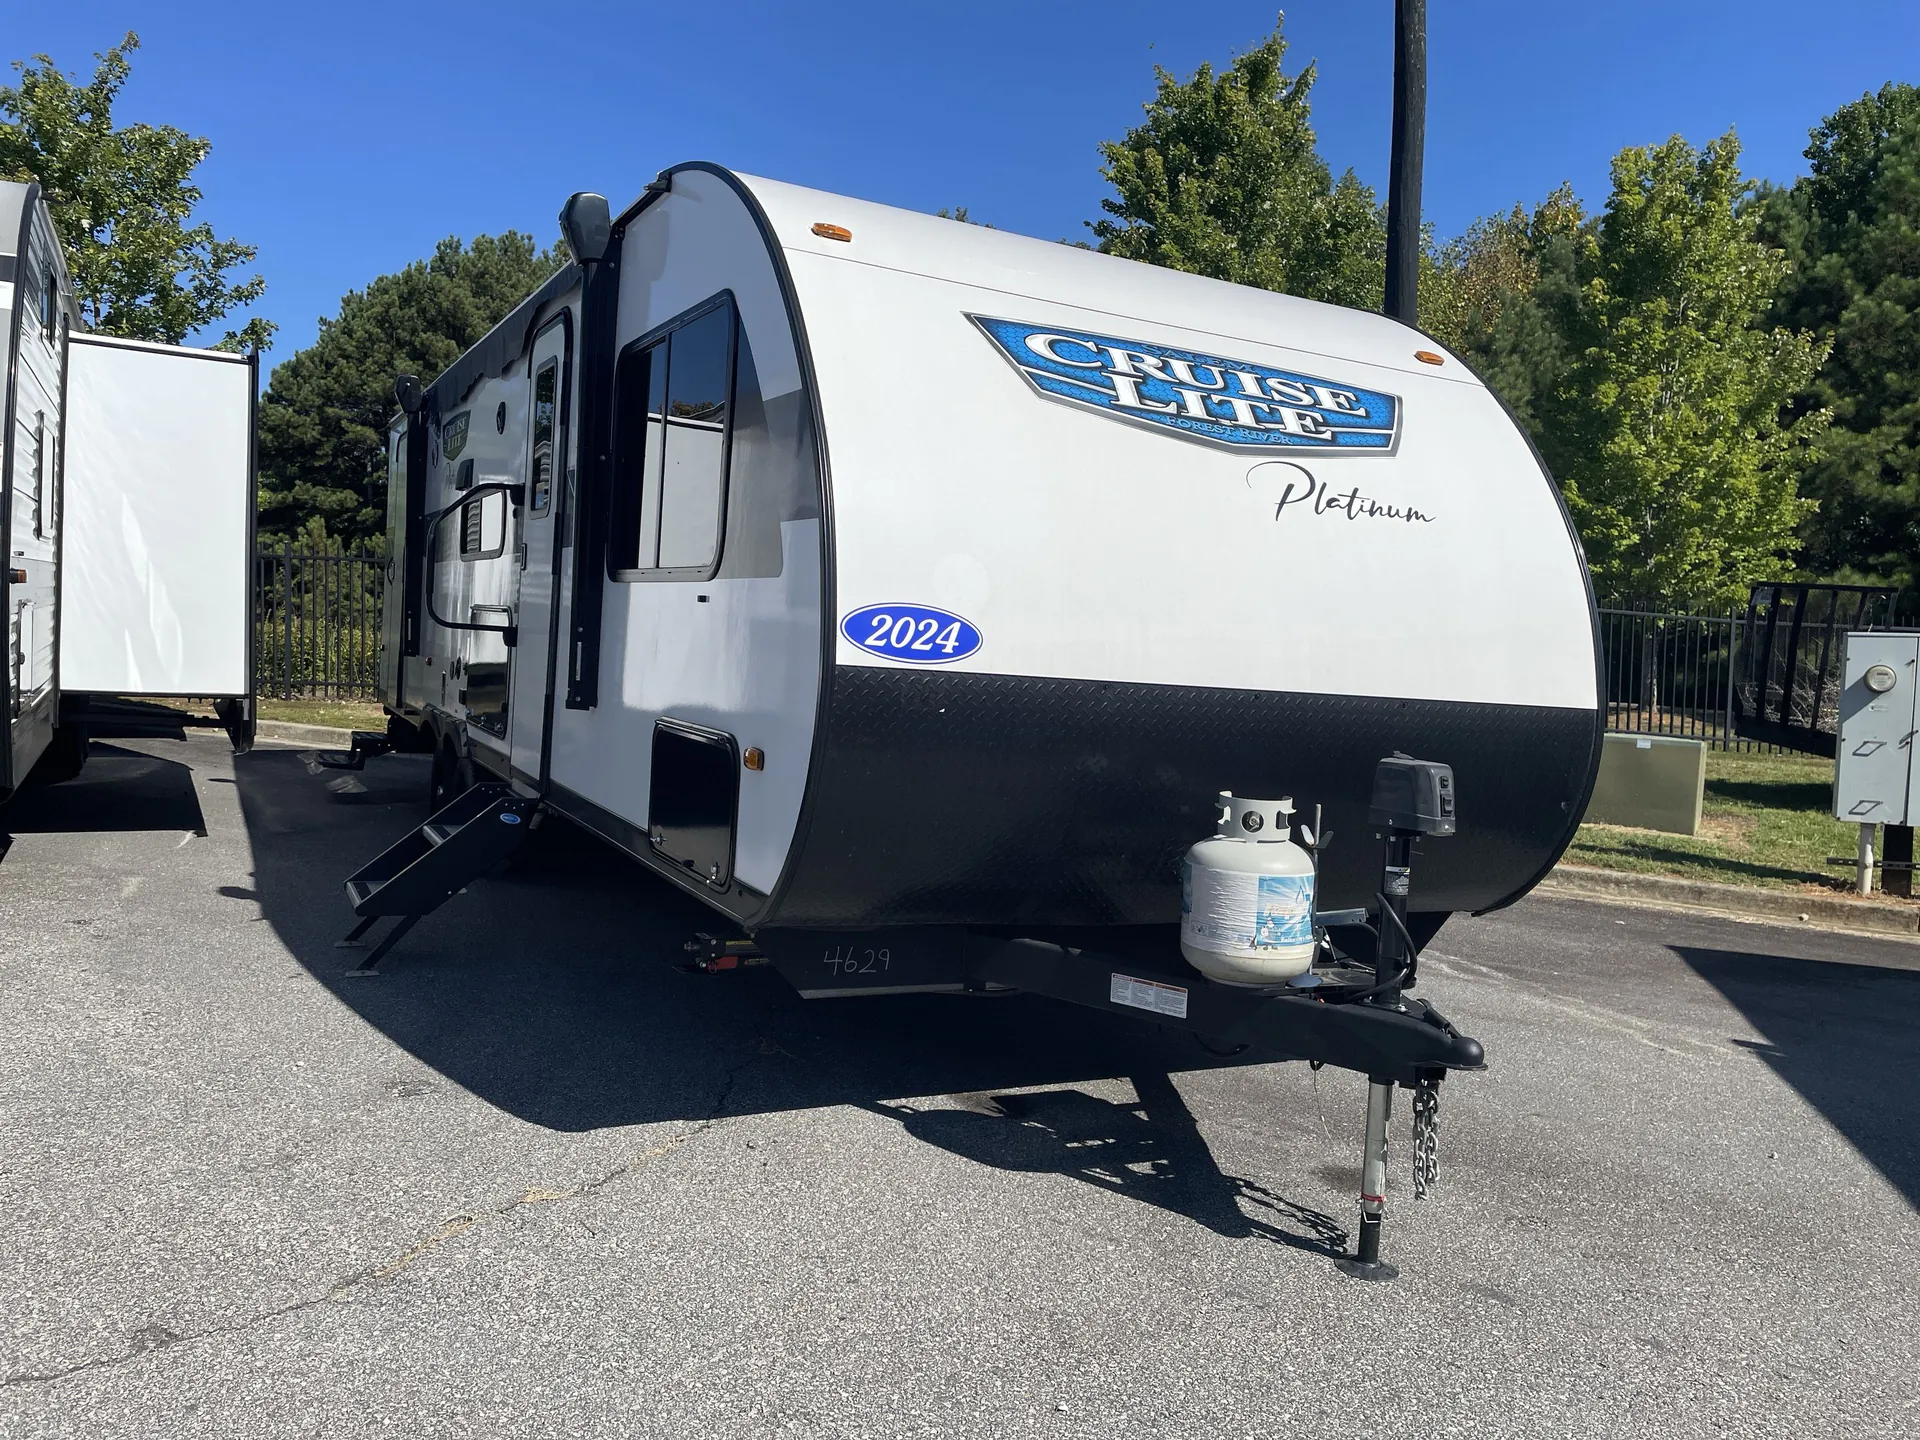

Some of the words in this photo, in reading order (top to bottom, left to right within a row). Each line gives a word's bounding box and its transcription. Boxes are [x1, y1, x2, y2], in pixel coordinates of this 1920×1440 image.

[1023, 333, 1367, 417] CRUISE
[1100, 372, 1332, 441] LITE
[1165, 416, 1236, 436] FOREST
[1239, 427, 1294, 445] RIVER
[1246, 461, 1437, 523] Platinum
[864, 614, 962, 654] 2024
[823, 945, 890, 976] 4629
